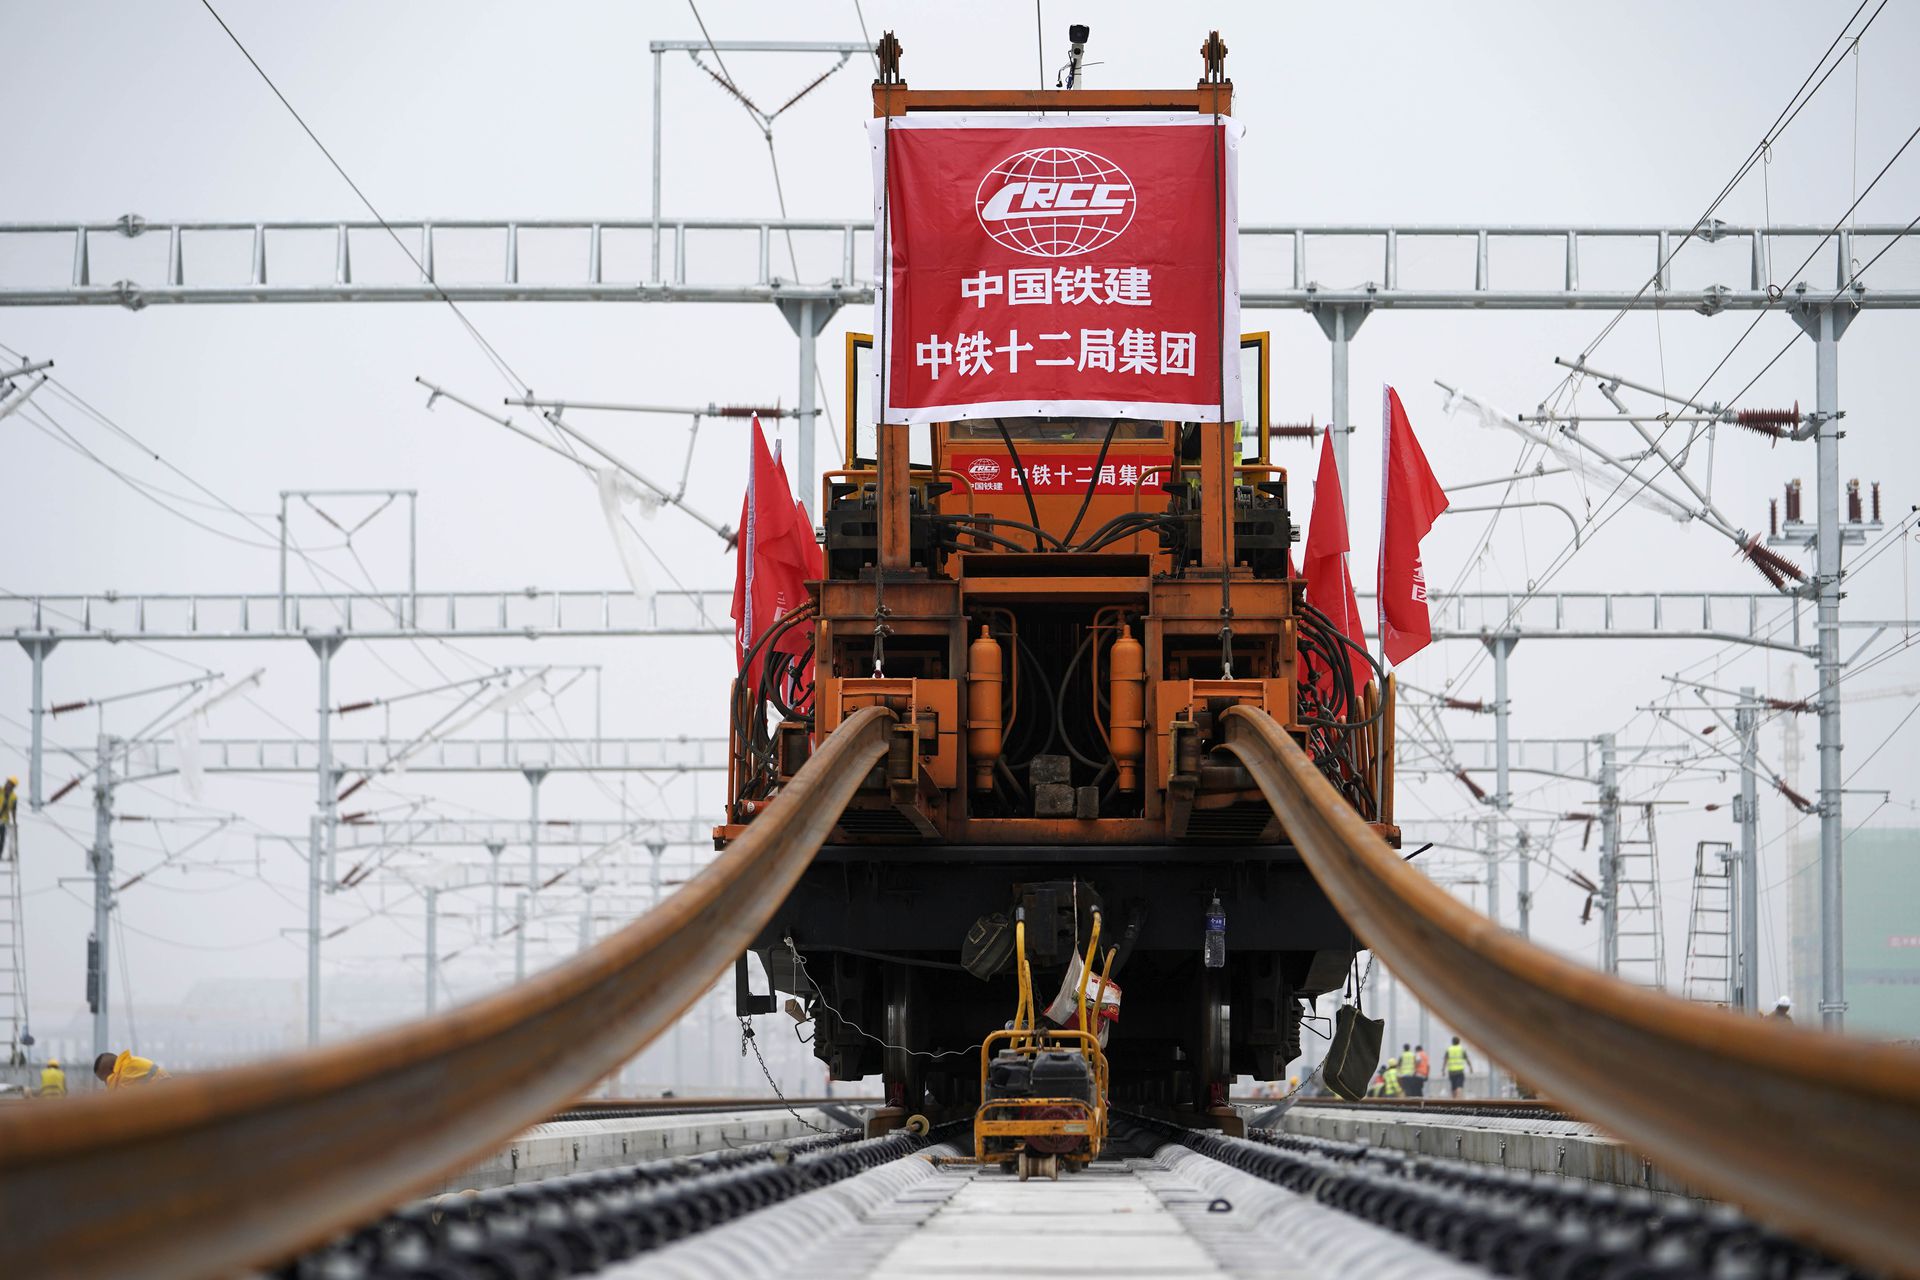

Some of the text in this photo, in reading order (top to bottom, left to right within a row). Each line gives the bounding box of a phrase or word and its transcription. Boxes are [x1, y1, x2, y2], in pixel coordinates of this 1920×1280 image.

[981, 181, 1131, 221] CRCC
[960, 265, 1153, 309] 中国铁建
[915, 327, 1197, 381] 中铁十二局集团
[969, 465, 1000, 474] CRCC
[1010, 464, 1160, 487] 中铁十二局集团
